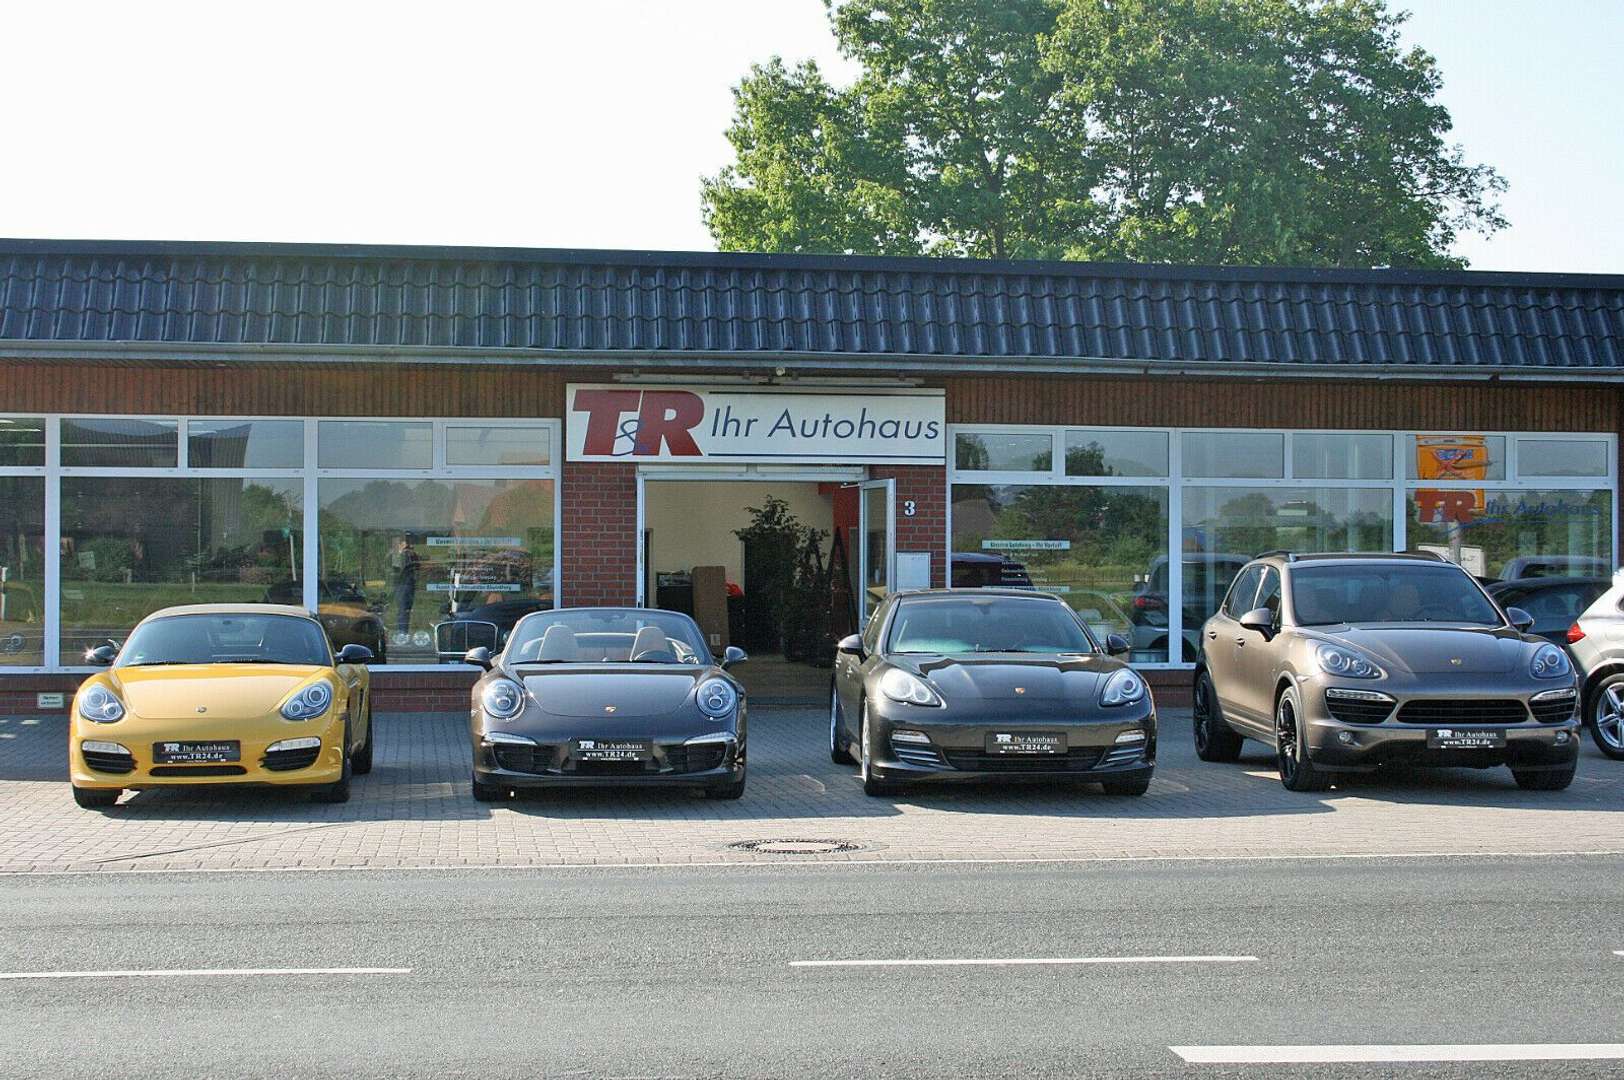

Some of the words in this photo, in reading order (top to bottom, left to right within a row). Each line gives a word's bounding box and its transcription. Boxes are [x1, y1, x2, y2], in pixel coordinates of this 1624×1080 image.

[572, 389, 705, 456] T&R
[711, 405, 759, 438] Ihr
[768, 406, 940, 439] Autohaus
[904, 500, 916, 516] 3
[1466, 731, 1497, 739] Autohaus
[195, 744, 230, 752] Autohaus
[170, 752, 223, 760] www.TR24.de
